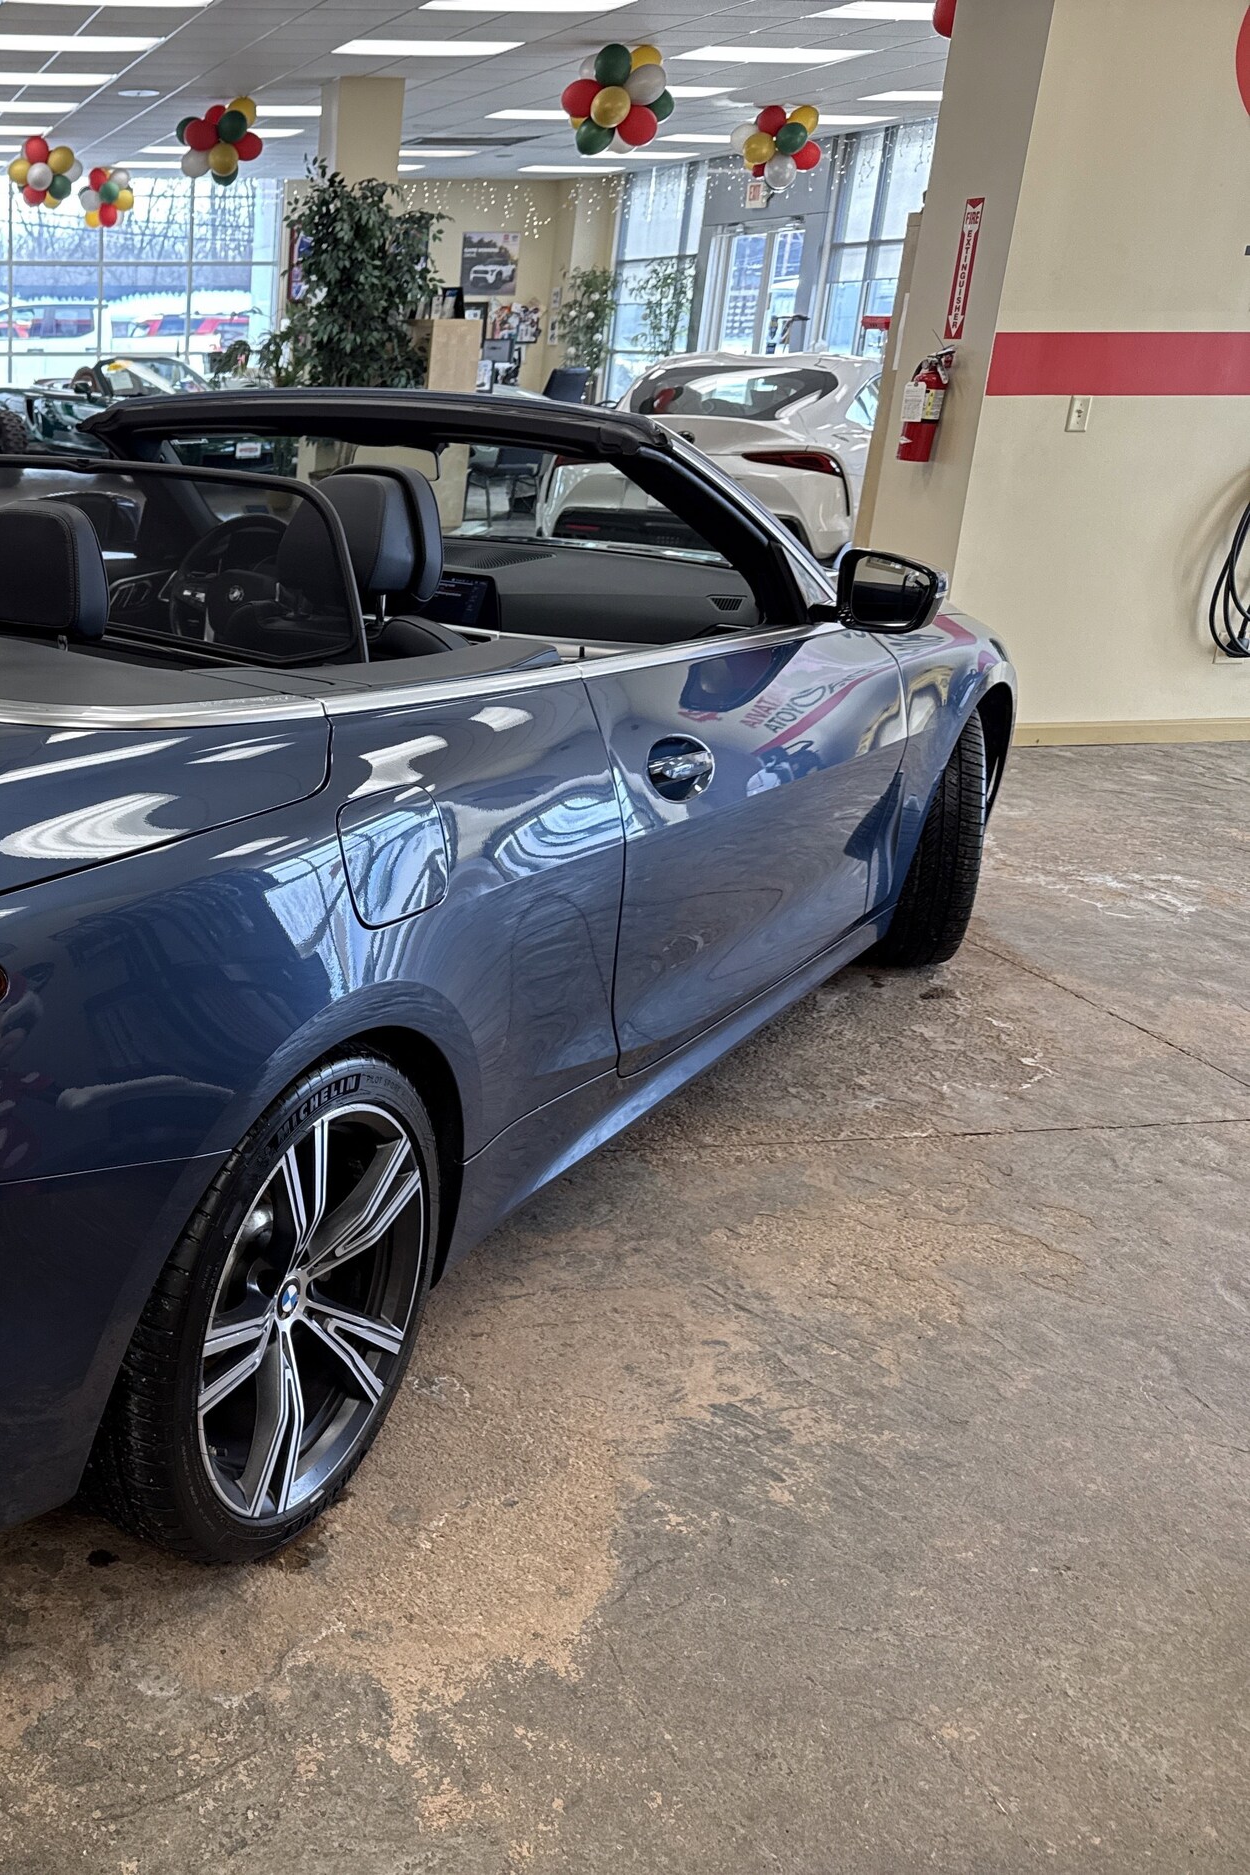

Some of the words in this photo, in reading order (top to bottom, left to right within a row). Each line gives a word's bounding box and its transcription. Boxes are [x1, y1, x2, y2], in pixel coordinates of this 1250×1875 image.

[965, 211, 980, 225] FIRE
[951, 229, 973, 329] EXTINGUISHER
[276, 1074, 357, 1146] MICHELIN
